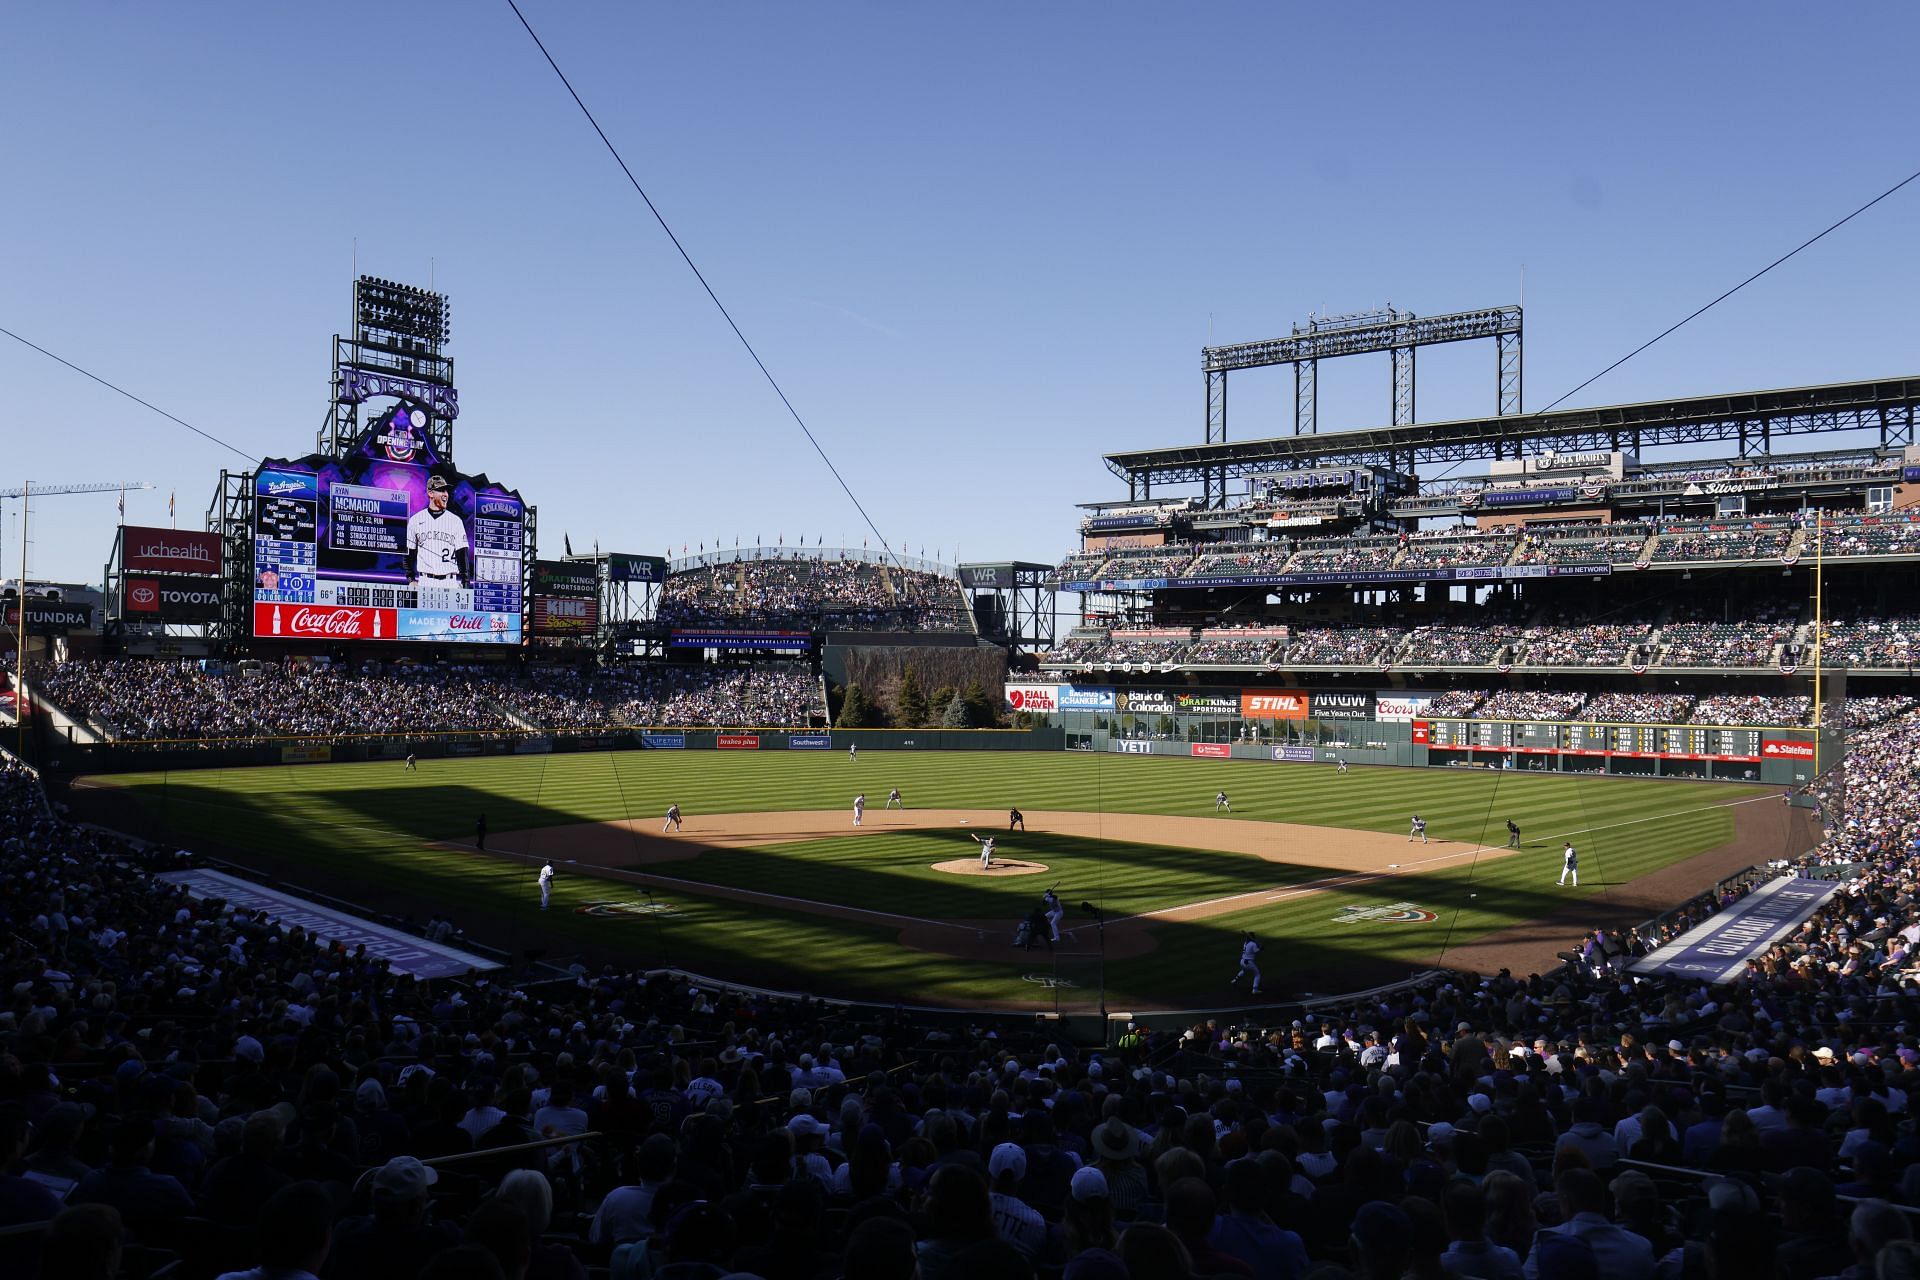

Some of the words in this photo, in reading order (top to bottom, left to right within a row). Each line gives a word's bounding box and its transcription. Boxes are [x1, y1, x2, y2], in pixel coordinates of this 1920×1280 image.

[341, 368, 460, 419] ROCKIES
[376, 434, 409, 448] OPENING
[410, 439, 424, 450] DAY
[1554, 454, 1573, 465] JACK
[335, 486, 350, 495] RYAN
[1705, 482, 1744, 494] Silver
[335, 496, 380, 514] MCMAHON
[481, 502, 518, 517] COLORADO
[288, 512, 297, 520] Lux
[337, 513, 355, 523] TODAY:
[373, 517, 384, 526] RUN
[350, 525, 370, 534] DOUBLED
[376, 527, 387, 535] LEFT
[140, 541, 209, 560] uchealth
[629, 560, 652, 576] WR
[973, 568, 997, 581] WR
[1574, 565, 1609, 573] NETWORK
[553, 583, 595, 591] SPORTSBOOK
[160, 591, 220, 605] TOYOTA
[546, 600, 586, 616] KING
[25, 611, 85, 624] TUNDRA
[291, 608, 361, 635] Coca-Cola
[409, 615, 436, 626] MADE
[450, 613, 483, 631] Chill
[1129, 689, 1153, 701] Bank
[1154, 690, 1165, 701] of
[1129, 700, 1173, 712] Colorado
[1180, 698, 1237, 706] DRAFTKINGS
[1250, 697, 1299, 711] STIHL
[1378, 701, 1413, 715] Coors
[720, 738, 741, 746] brakes
[742, 738, 757, 747] plus
[1120, 740, 1150, 753] YETI
[1697, 915, 1781, 957] COLORADO
[344, 935, 428, 961] FIELD
